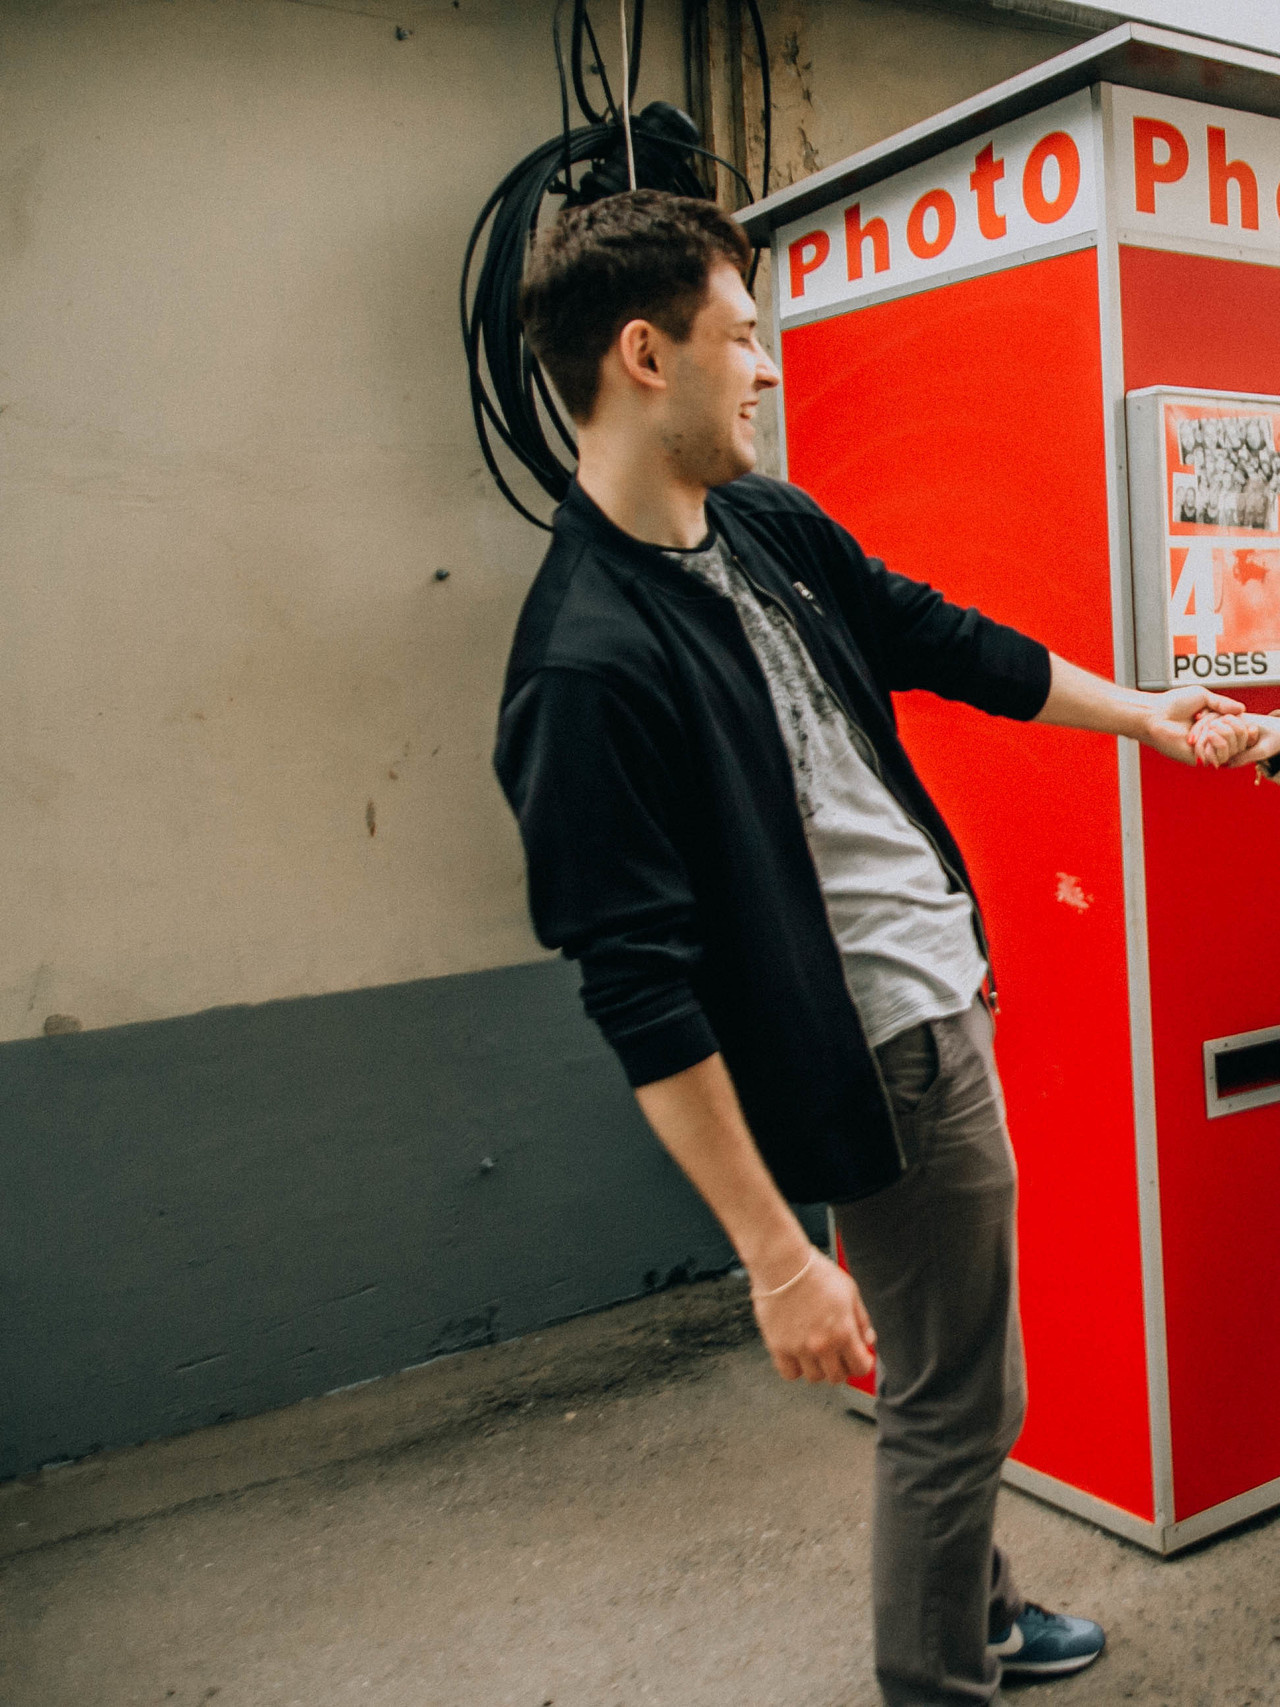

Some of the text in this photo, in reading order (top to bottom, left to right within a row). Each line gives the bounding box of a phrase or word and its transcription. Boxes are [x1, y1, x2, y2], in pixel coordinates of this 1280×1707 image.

[787, 130, 1081, 299] Photo
[1168, 547, 1224, 655] 4
[1174, 651, 1268, 678] POSES
